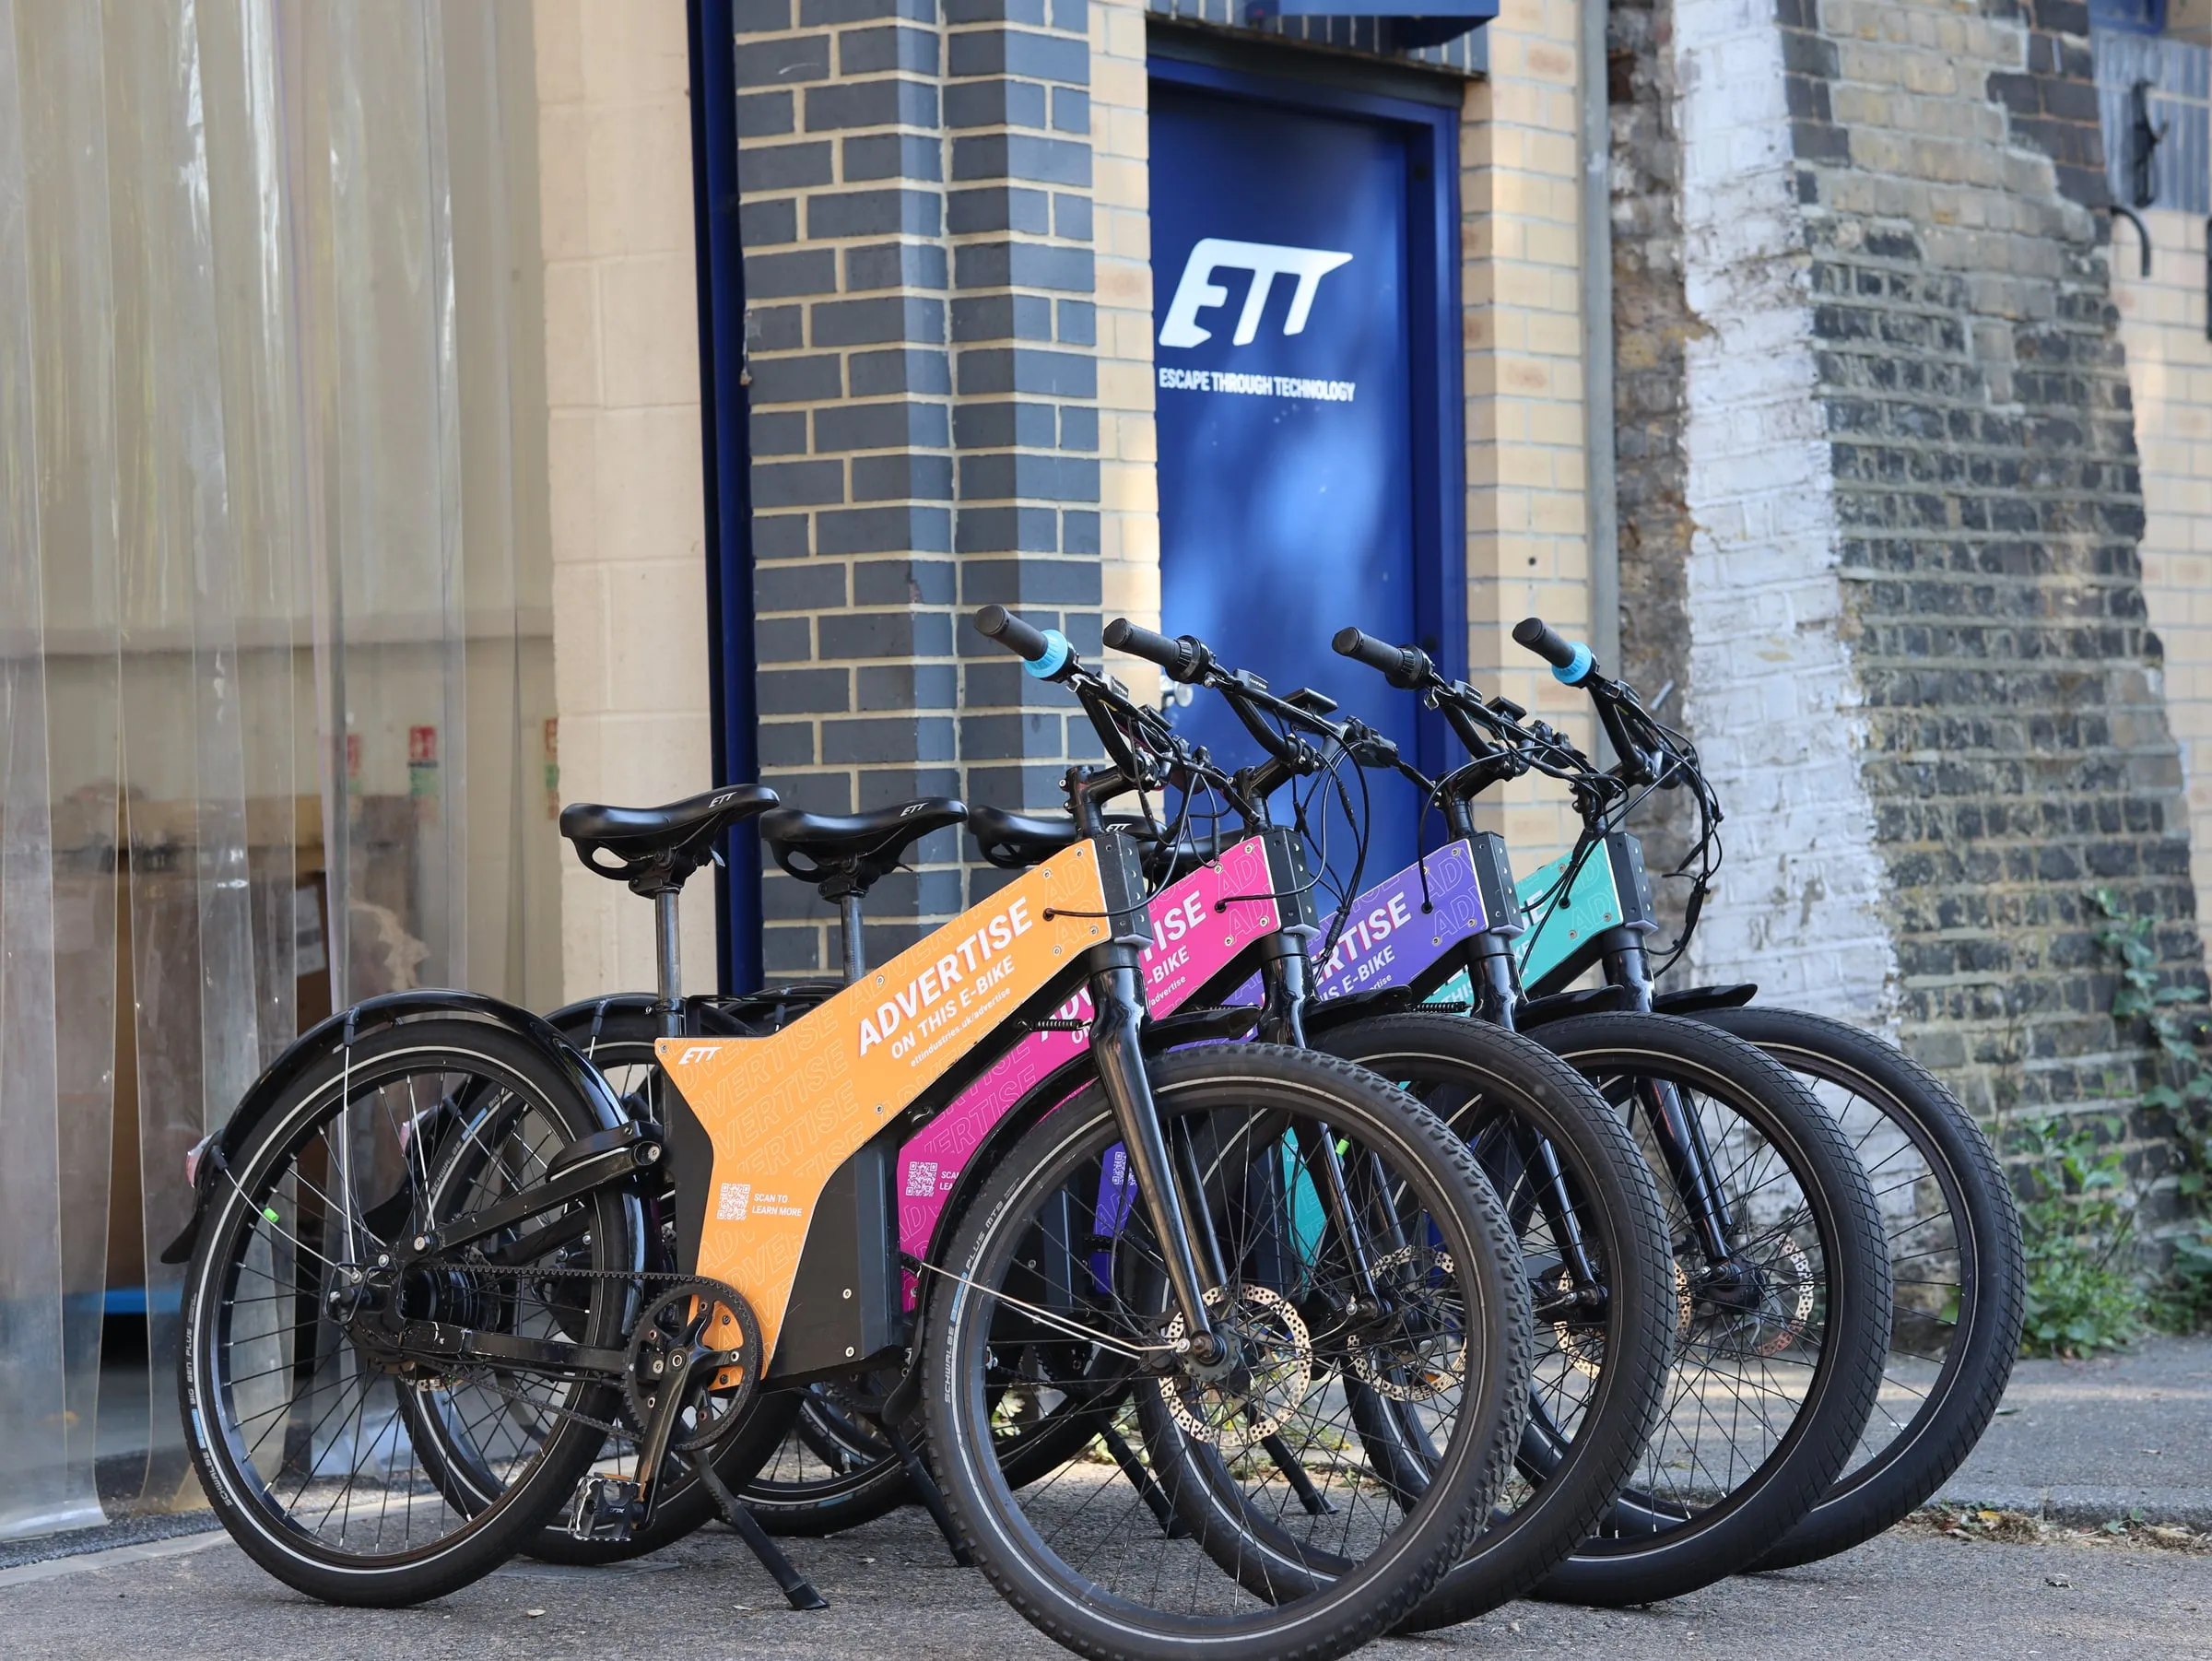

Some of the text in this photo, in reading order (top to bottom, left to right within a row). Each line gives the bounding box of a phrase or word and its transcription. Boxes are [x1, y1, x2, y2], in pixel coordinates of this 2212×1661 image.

[1159, 238, 1353, 348] ETT
[1159, 368, 1356, 402] ESCAPE THROUGH TECHNOLOGY
[709, 791, 737, 808] ETT
[900, 802, 928, 818] ETT
[858, 896, 1033, 1057] ADVERTISE
[1341, 945, 1395, 994] E-BIKE
[891, 954, 1016, 1059] ON THIS E-BIKE
[677, 1046, 724, 1065] ETT
[752, 1205, 803, 1217] LEARN MORE
[753, 1193, 789, 1204] SCAN TO
[944, 1200, 1005, 1404] SCHWALBE PLUS MTB
[185, 1328, 194, 1359] PLUS
[202, 1451, 234, 1506] SCHWALBE
